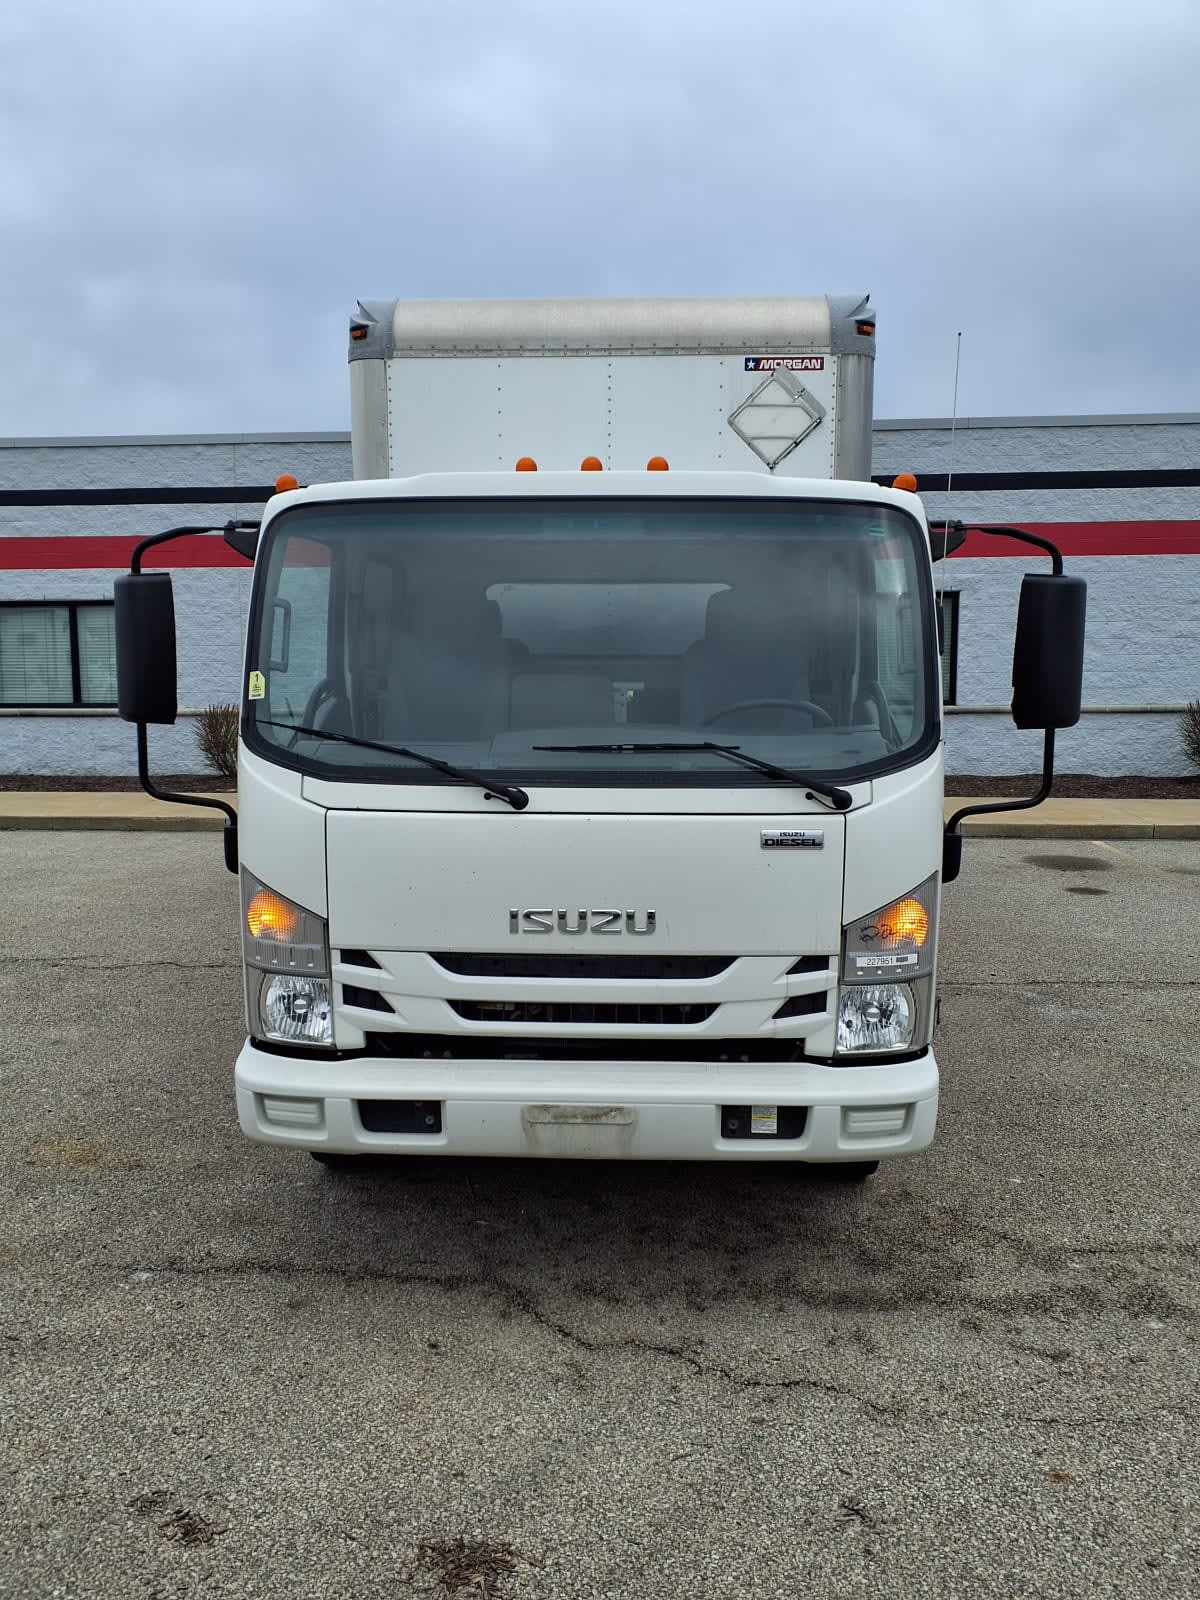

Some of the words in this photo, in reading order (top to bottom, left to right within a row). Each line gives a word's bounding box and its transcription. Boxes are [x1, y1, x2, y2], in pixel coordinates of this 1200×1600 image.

[759, 359, 821, 369] MORGAN
[763, 838, 823, 847] DIESEL
[509, 908, 657, 936] ISUZU
